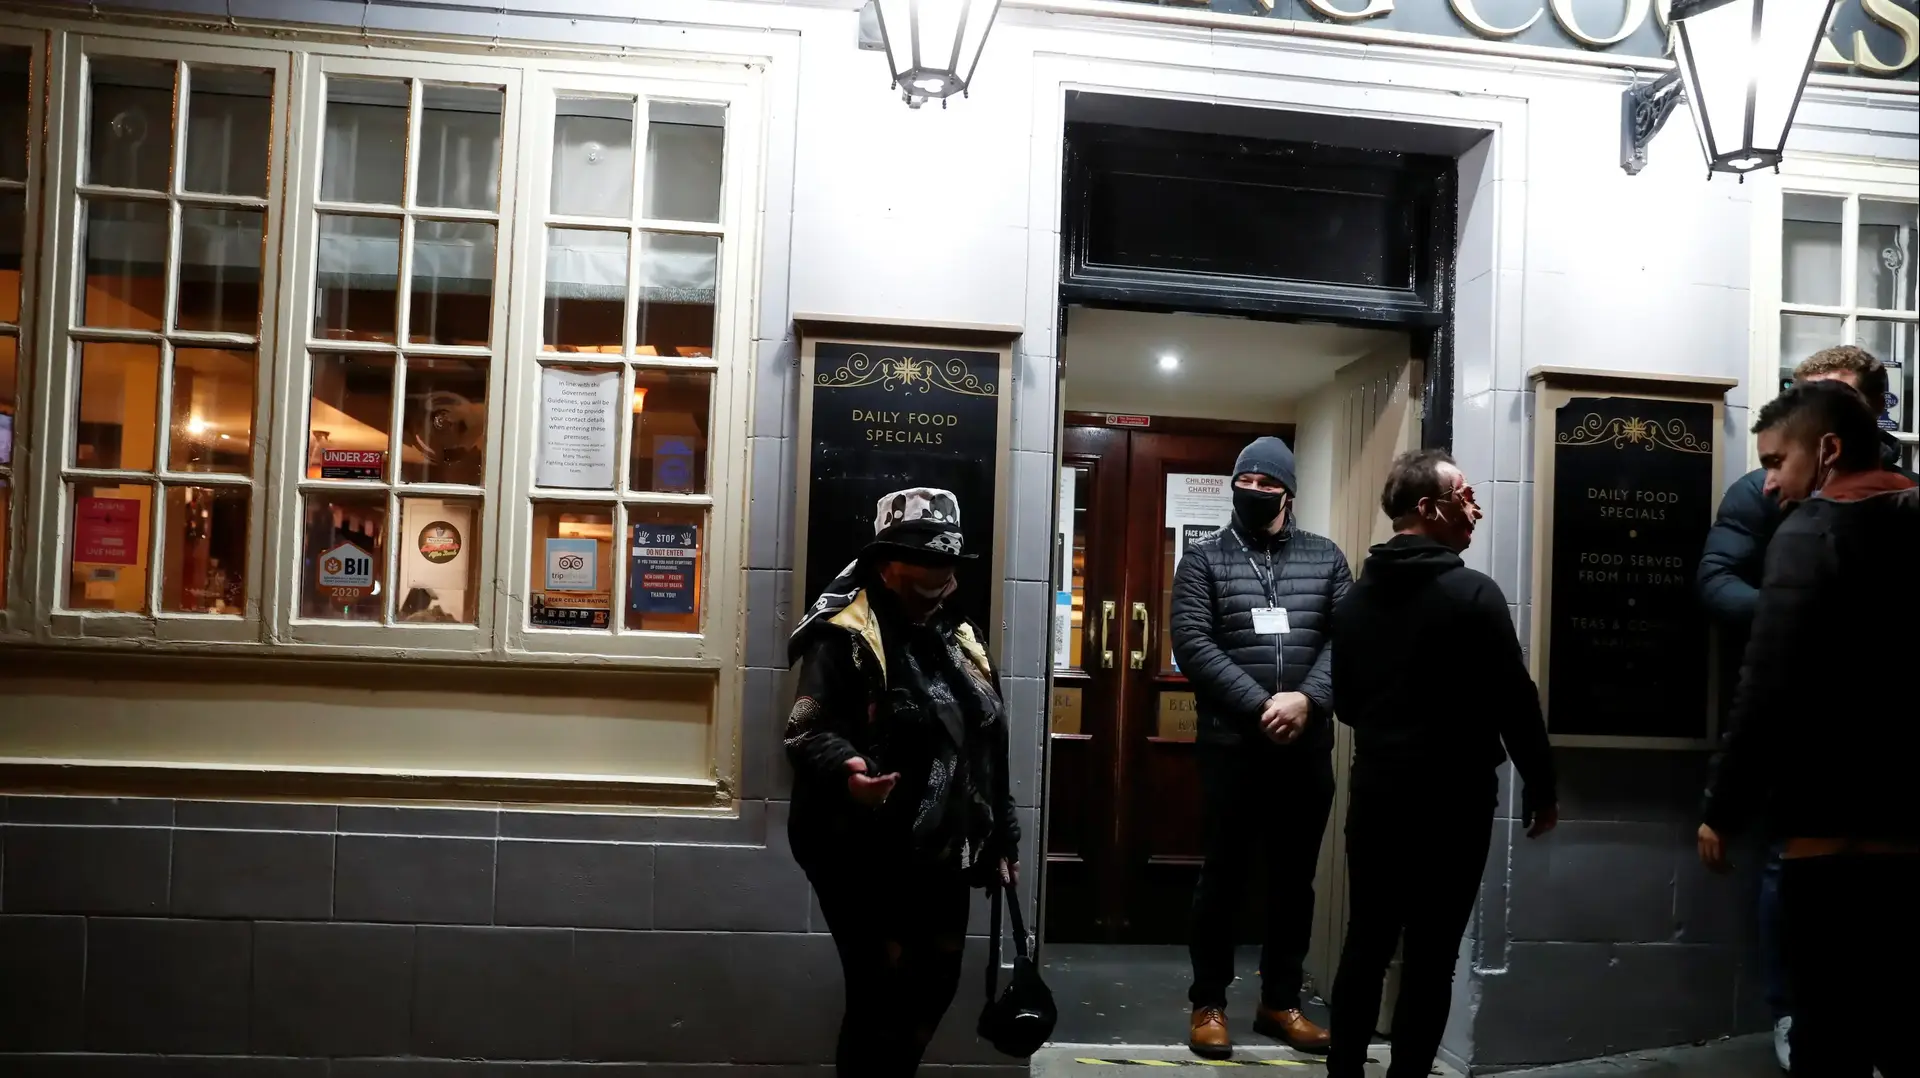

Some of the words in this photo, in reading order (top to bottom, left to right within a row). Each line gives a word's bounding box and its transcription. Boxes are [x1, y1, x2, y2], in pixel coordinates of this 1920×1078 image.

[551, 407, 576, 415] required
[852, 409, 900, 424] DAILY
[908, 412, 958, 427] FOOD
[866, 429, 943, 445] SPECIALS
[324, 452, 360, 462] UNDER
[362, 452, 380, 463] 25?
[1185, 478, 1224, 486] CHILDRENS
[1587, 488, 1630, 502] DAILY
[1636, 490, 1678, 504] FOOD
[1600, 506, 1666, 520] SPECIALS
[656, 534, 675, 543] STOP
[666, 549, 684, 557] ENTER
[344, 558, 369, 575] BII
[1580, 553, 1624, 566] FOOD
[1630, 554, 1683, 568] SERVED
[1578, 570, 1619, 583] FROM
[332, 588, 360, 597] 2020
